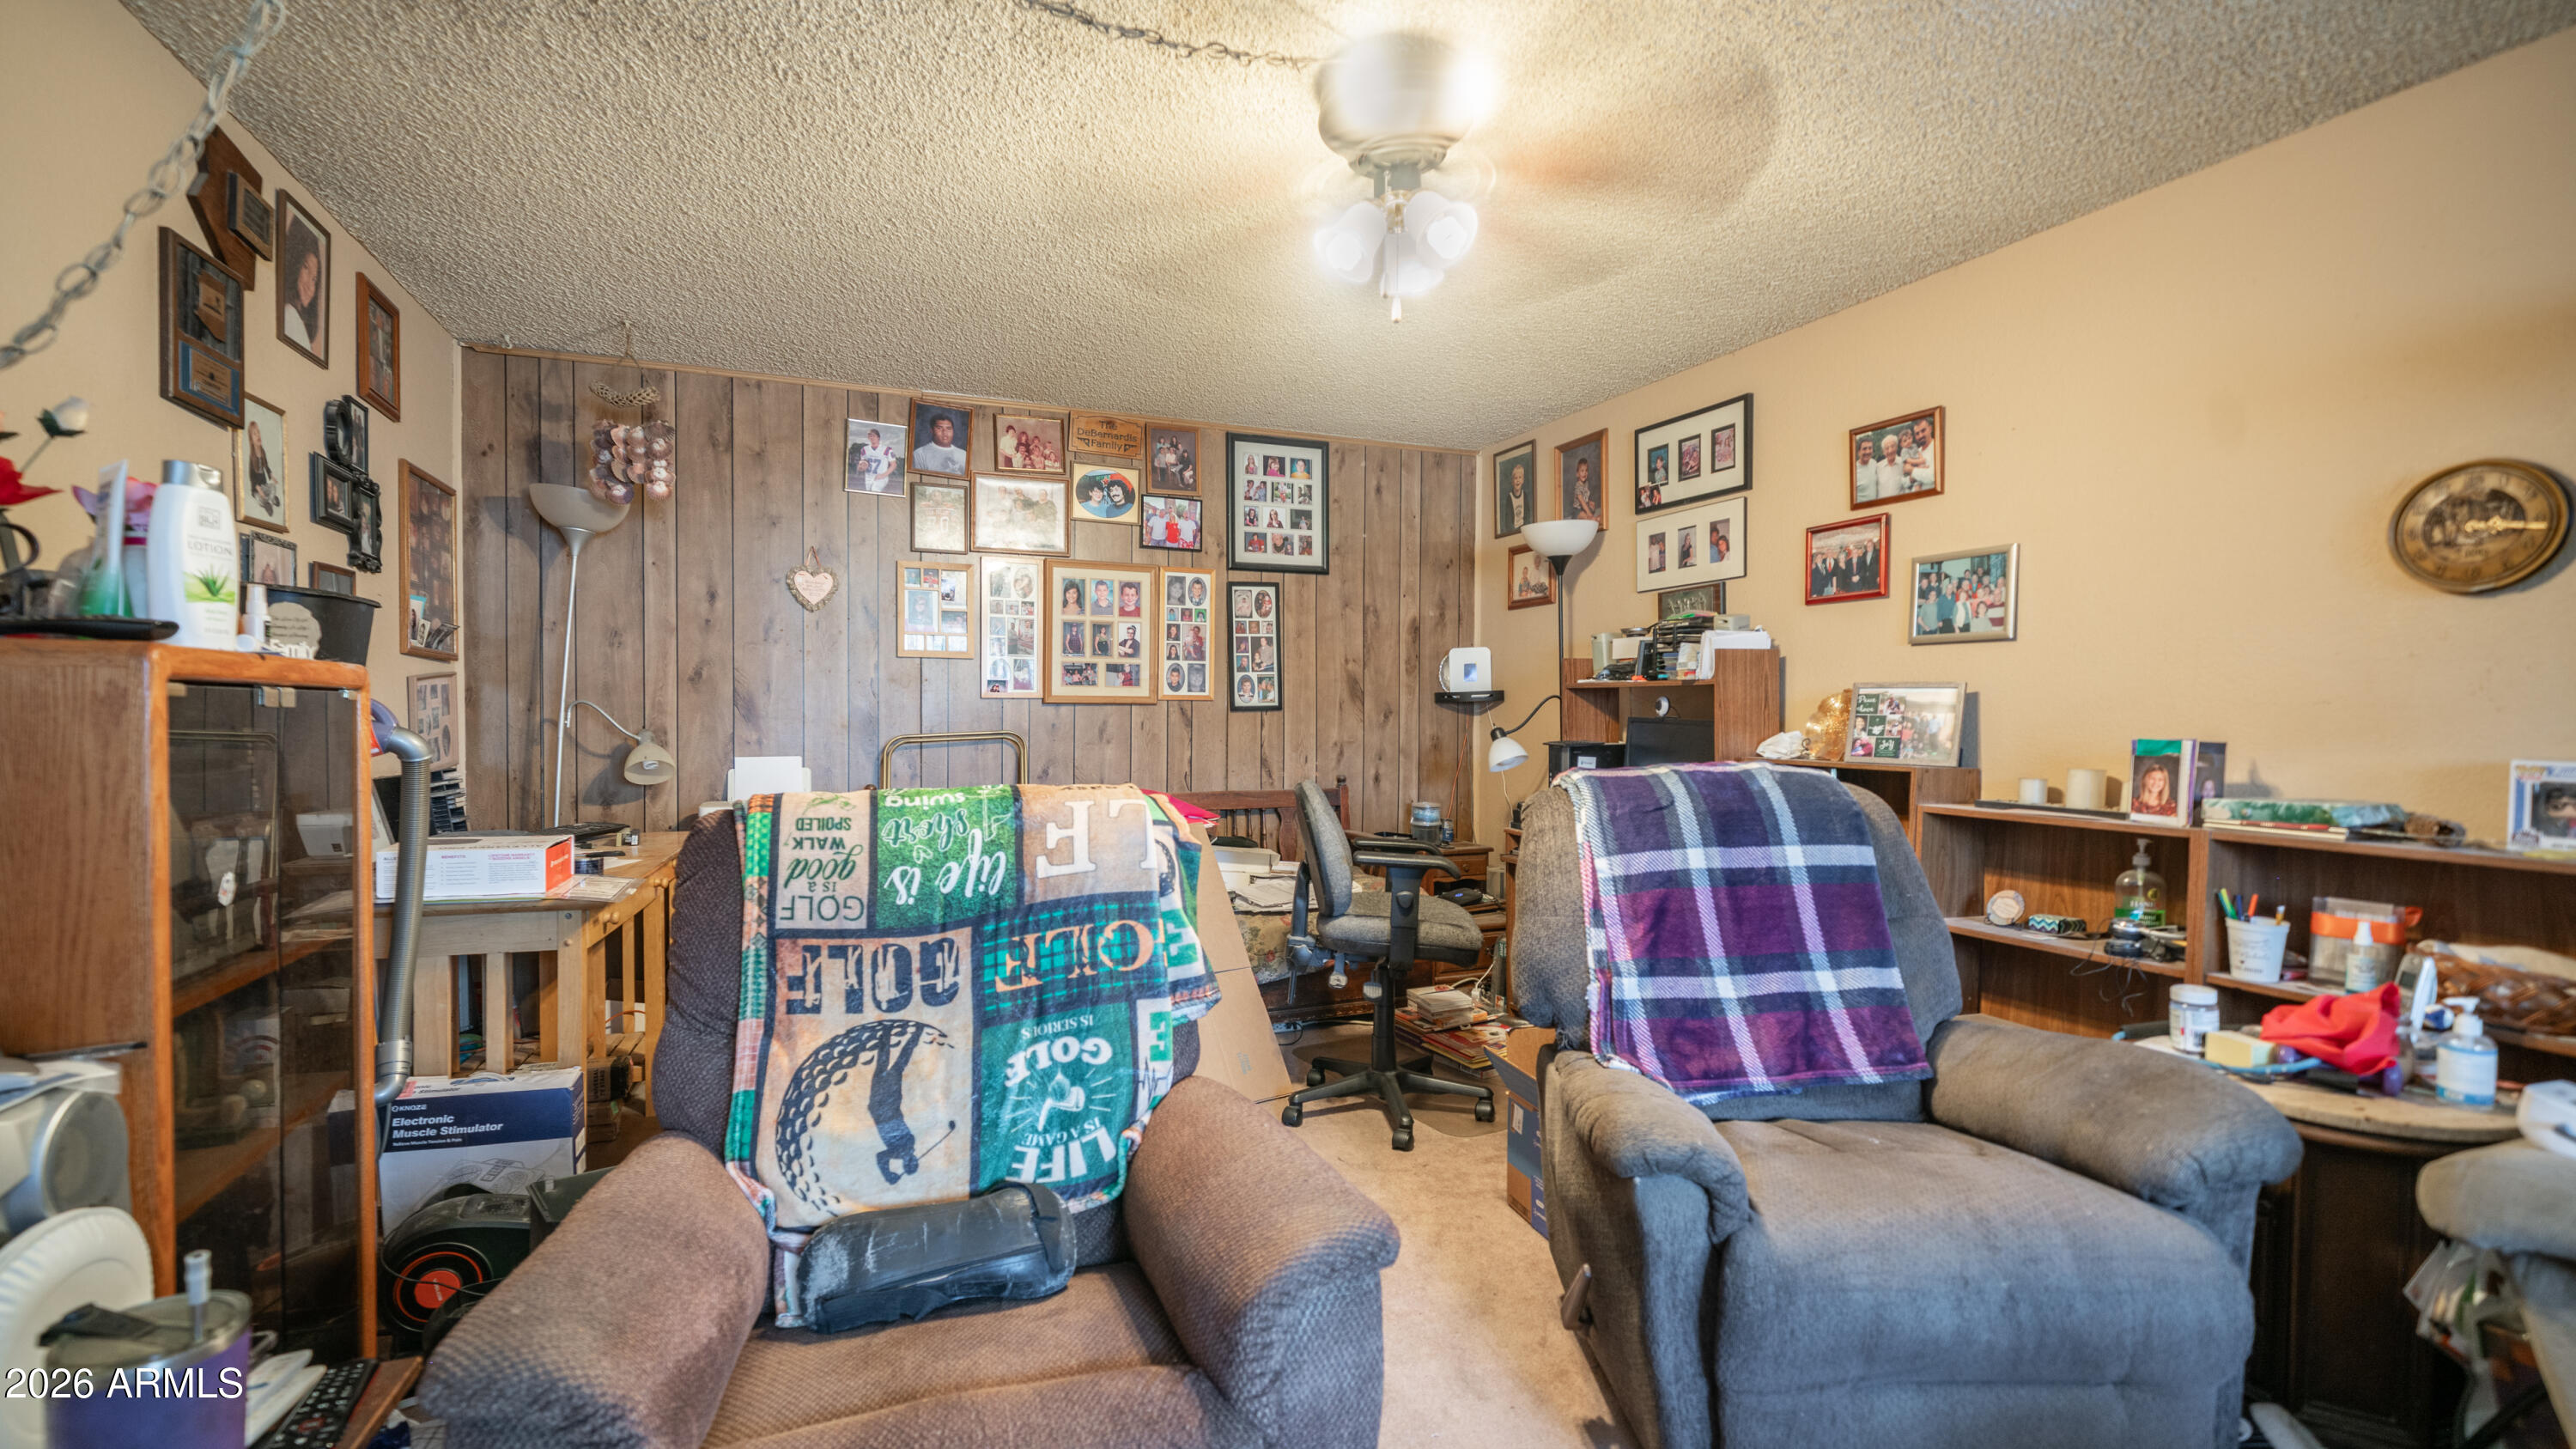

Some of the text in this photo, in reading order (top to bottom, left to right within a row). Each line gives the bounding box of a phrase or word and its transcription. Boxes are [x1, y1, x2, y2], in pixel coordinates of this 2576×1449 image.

[1099, 420, 1117, 430] The
[1091, 439, 1123, 452] Family
[187, 540, 233, 556] LOTION
[884, 792, 966, 811] swing
[795, 817, 852, 831] SPOILED
[881, 808, 969, 851] short
[792, 837, 846, 850] WALK
[783, 844, 864, 889] good
[884, 828, 1007, 905] life is
[779, 895, 865, 922] GOLF
[786, 937, 960, 1015] GOLF
[1080, 1014, 1094, 1026] IS
[1004, 1035, 1114, 1088] GOLF
[392, 1115, 455, 1127] Electronic
[392, 1123, 504, 1139] Muscle Stimulator
[1024, 1117, 1101, 1148] IS A GAME
[1005, 1126, 1117, 1184] LIFE
